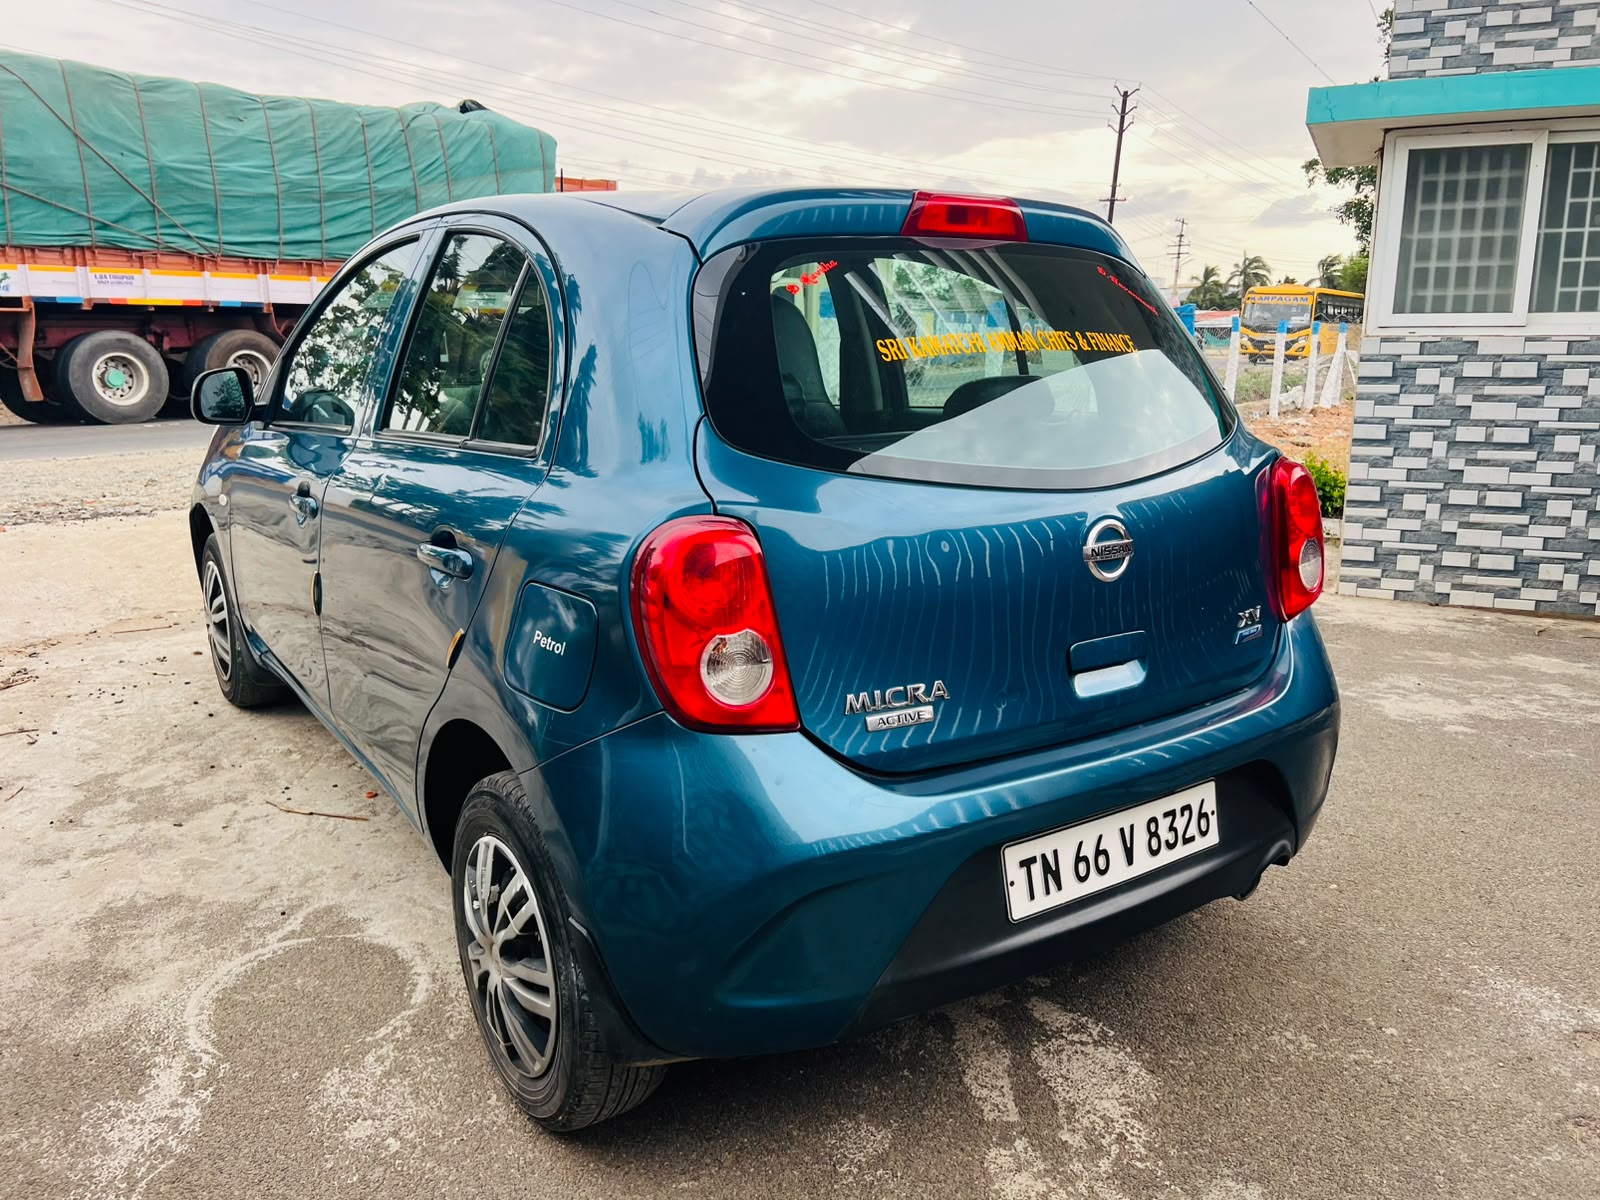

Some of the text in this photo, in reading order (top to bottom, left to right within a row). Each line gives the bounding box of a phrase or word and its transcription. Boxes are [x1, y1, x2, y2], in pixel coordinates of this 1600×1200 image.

[1250, 295, 1309, 303] KARPAGAM
[876, 331, 1138, 362] SRI KAMATCHI AMMAN CHITS & FINANCE
[1090, 544, 1132, 558] NISSAN
[1238, 605, 1261, 628] XV
[533, 629, 566, 656] Petrol
[845, 680, 950, 715] MICRA
[877, 710, 926, 727] ACTIVE
[1018, 798, 1210, 901] TN 66 V 8326
